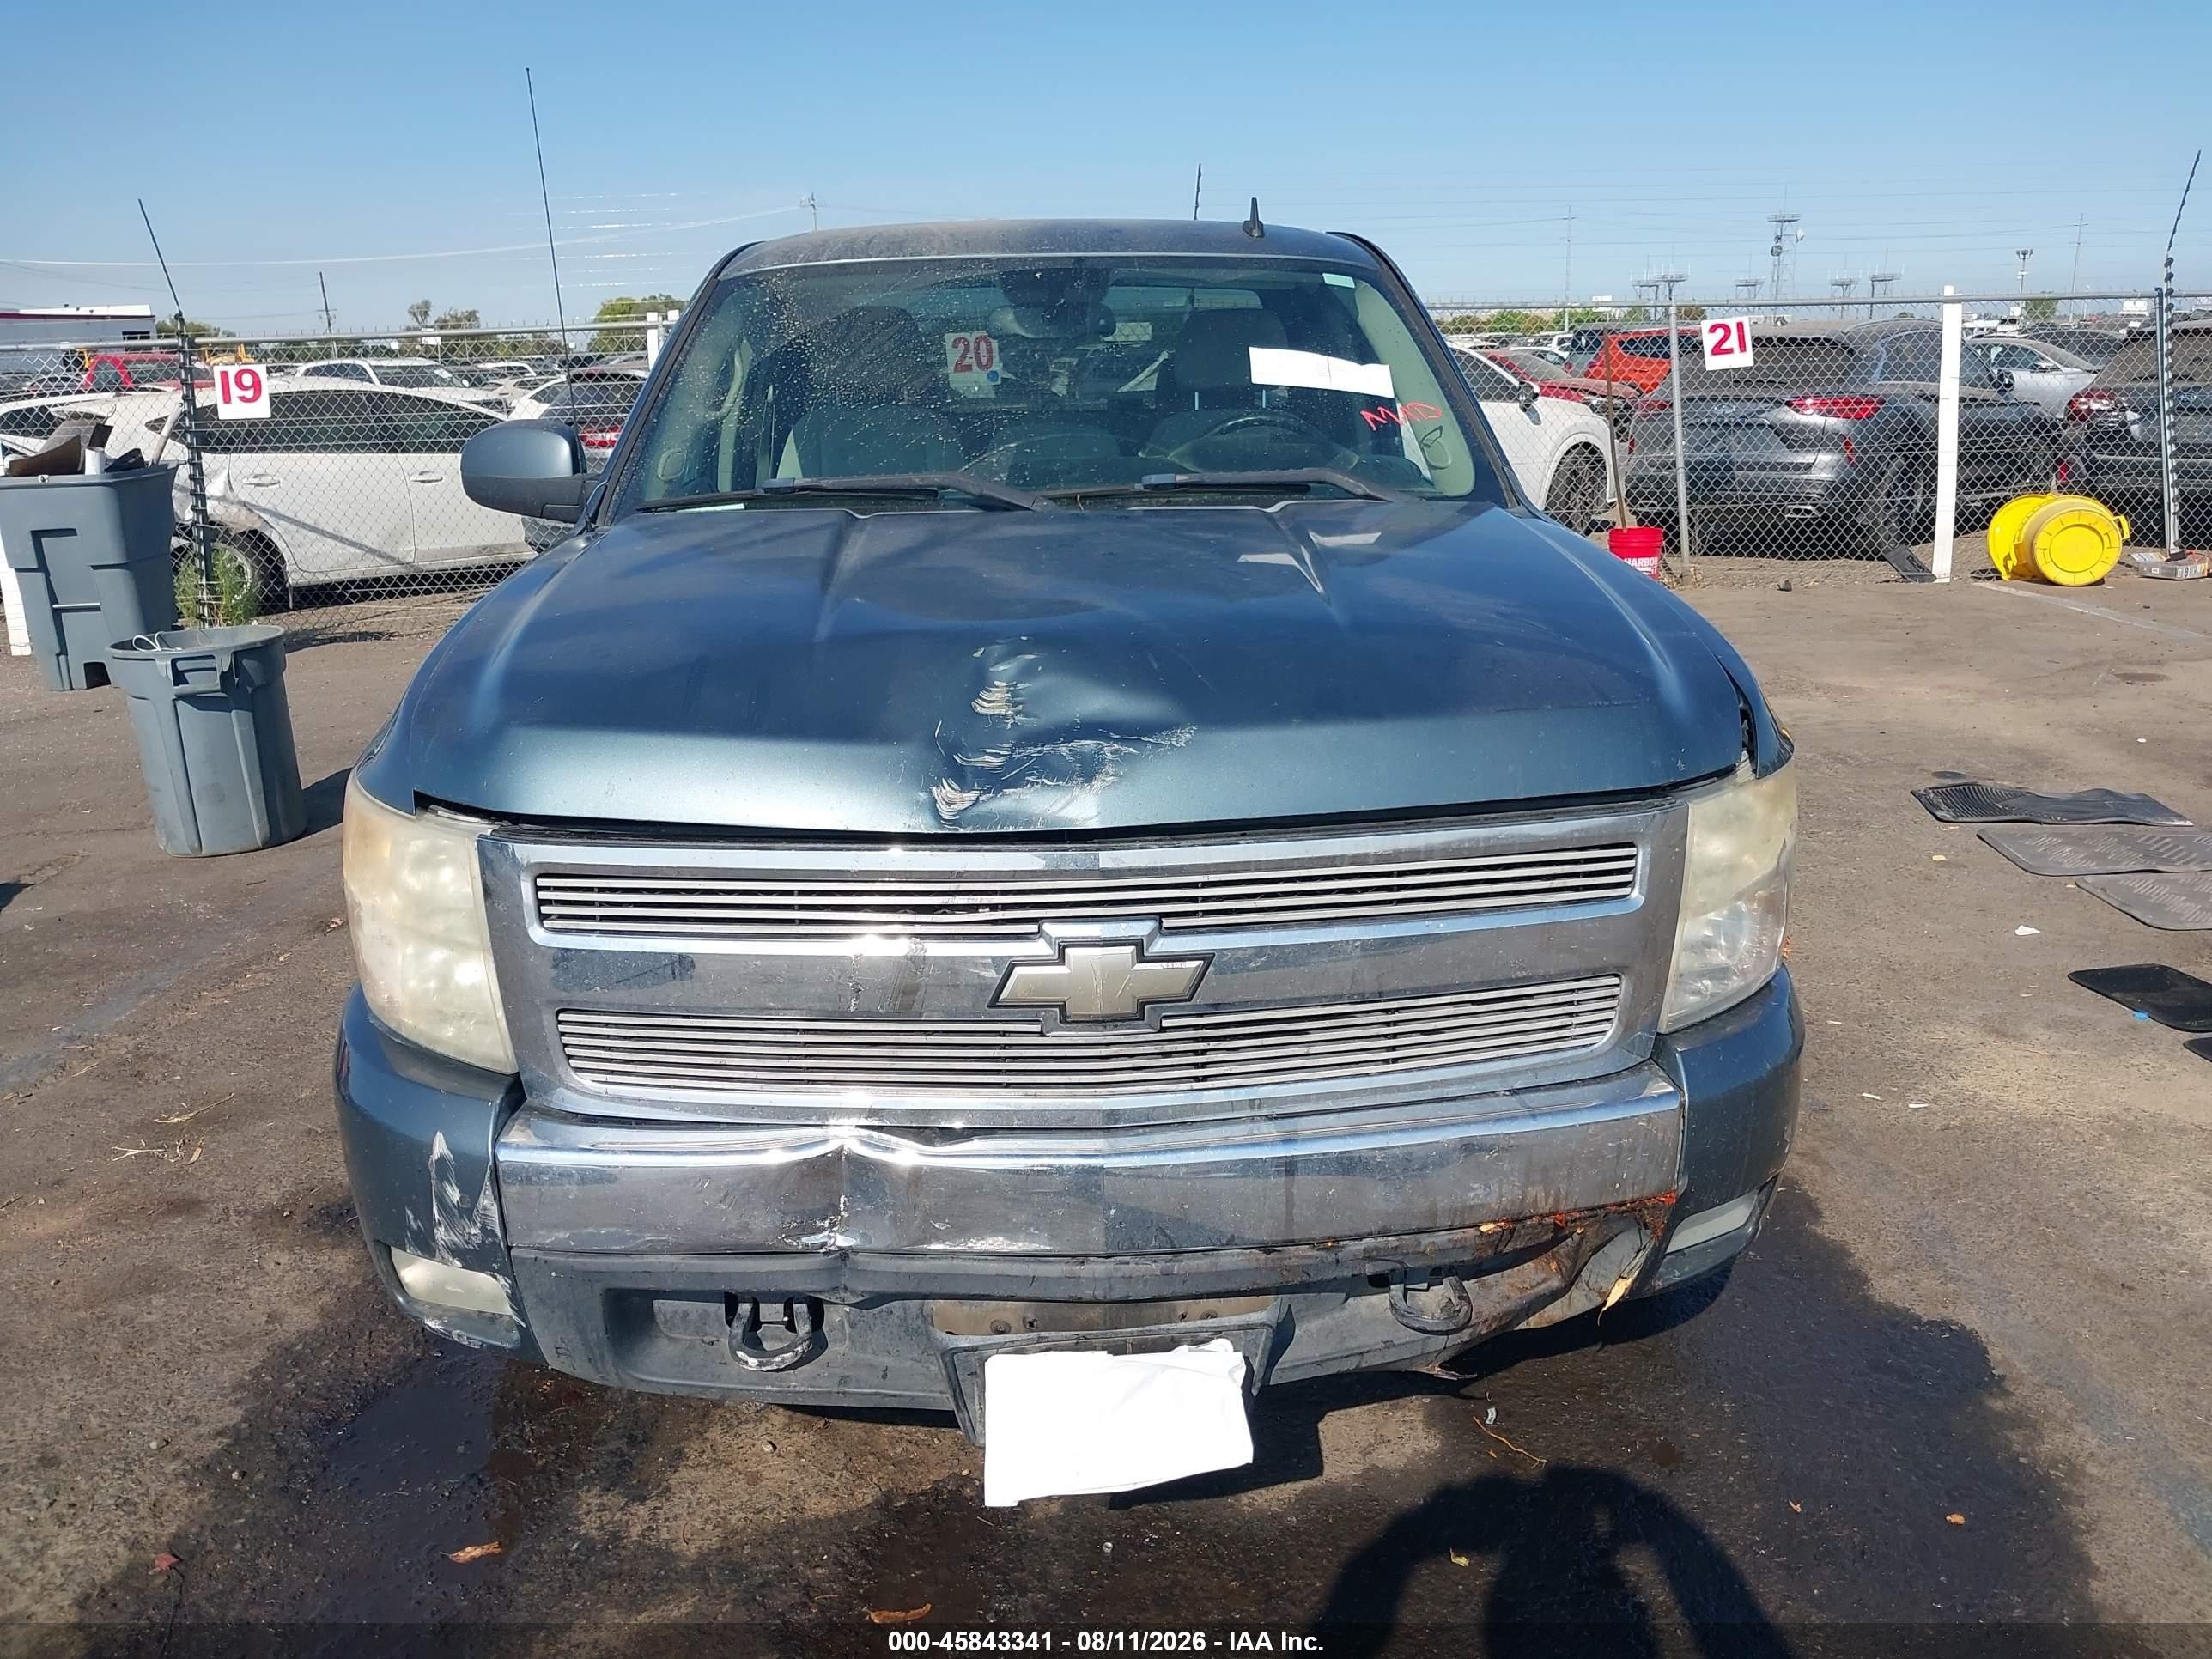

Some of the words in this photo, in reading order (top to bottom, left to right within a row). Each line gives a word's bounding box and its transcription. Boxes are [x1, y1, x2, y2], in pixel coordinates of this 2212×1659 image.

[951, 335, 994, 372] 20
[1708, 321, 1747, 356] 21
[220, 368, 262, 404] 19
